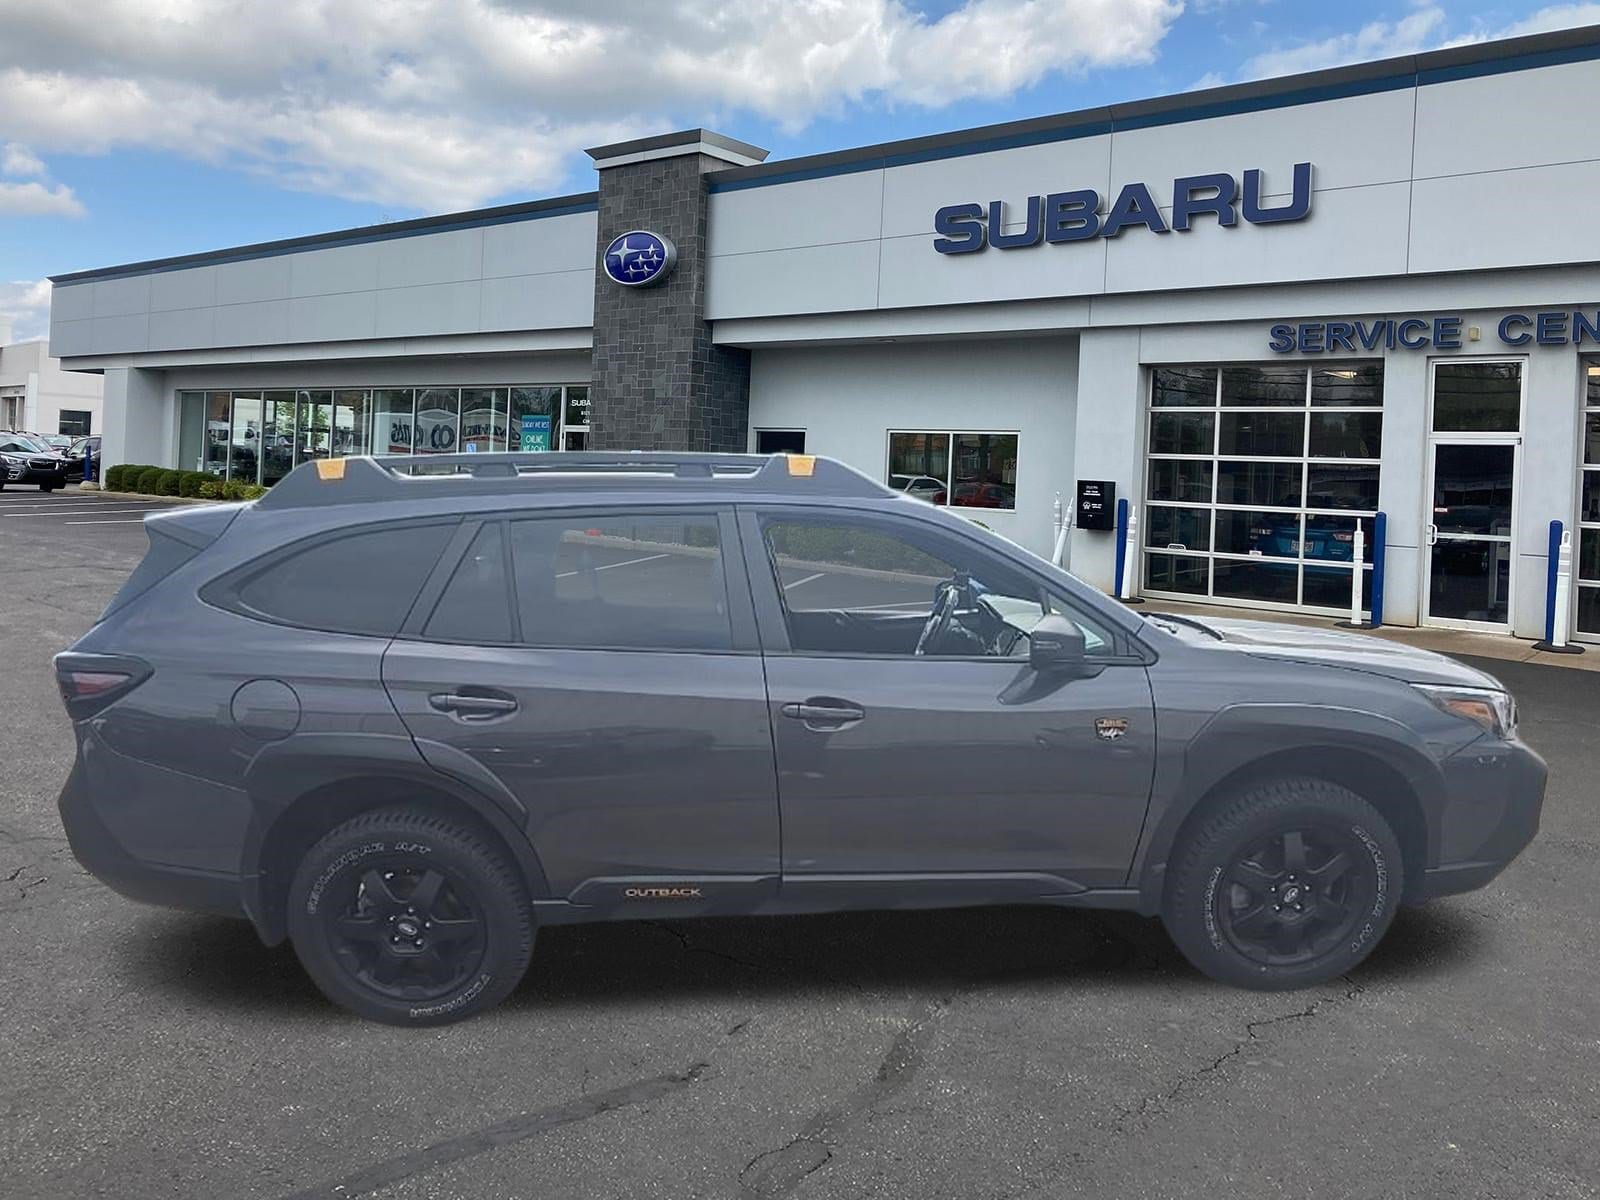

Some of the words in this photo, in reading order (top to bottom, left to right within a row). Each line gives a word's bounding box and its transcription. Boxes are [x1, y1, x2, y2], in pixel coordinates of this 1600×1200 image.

[934, 162, 1313, 255] SUBARU
[1269, 317, 1462, 354] SERVICE
[625, 888, 702, 898] OUTBACK
